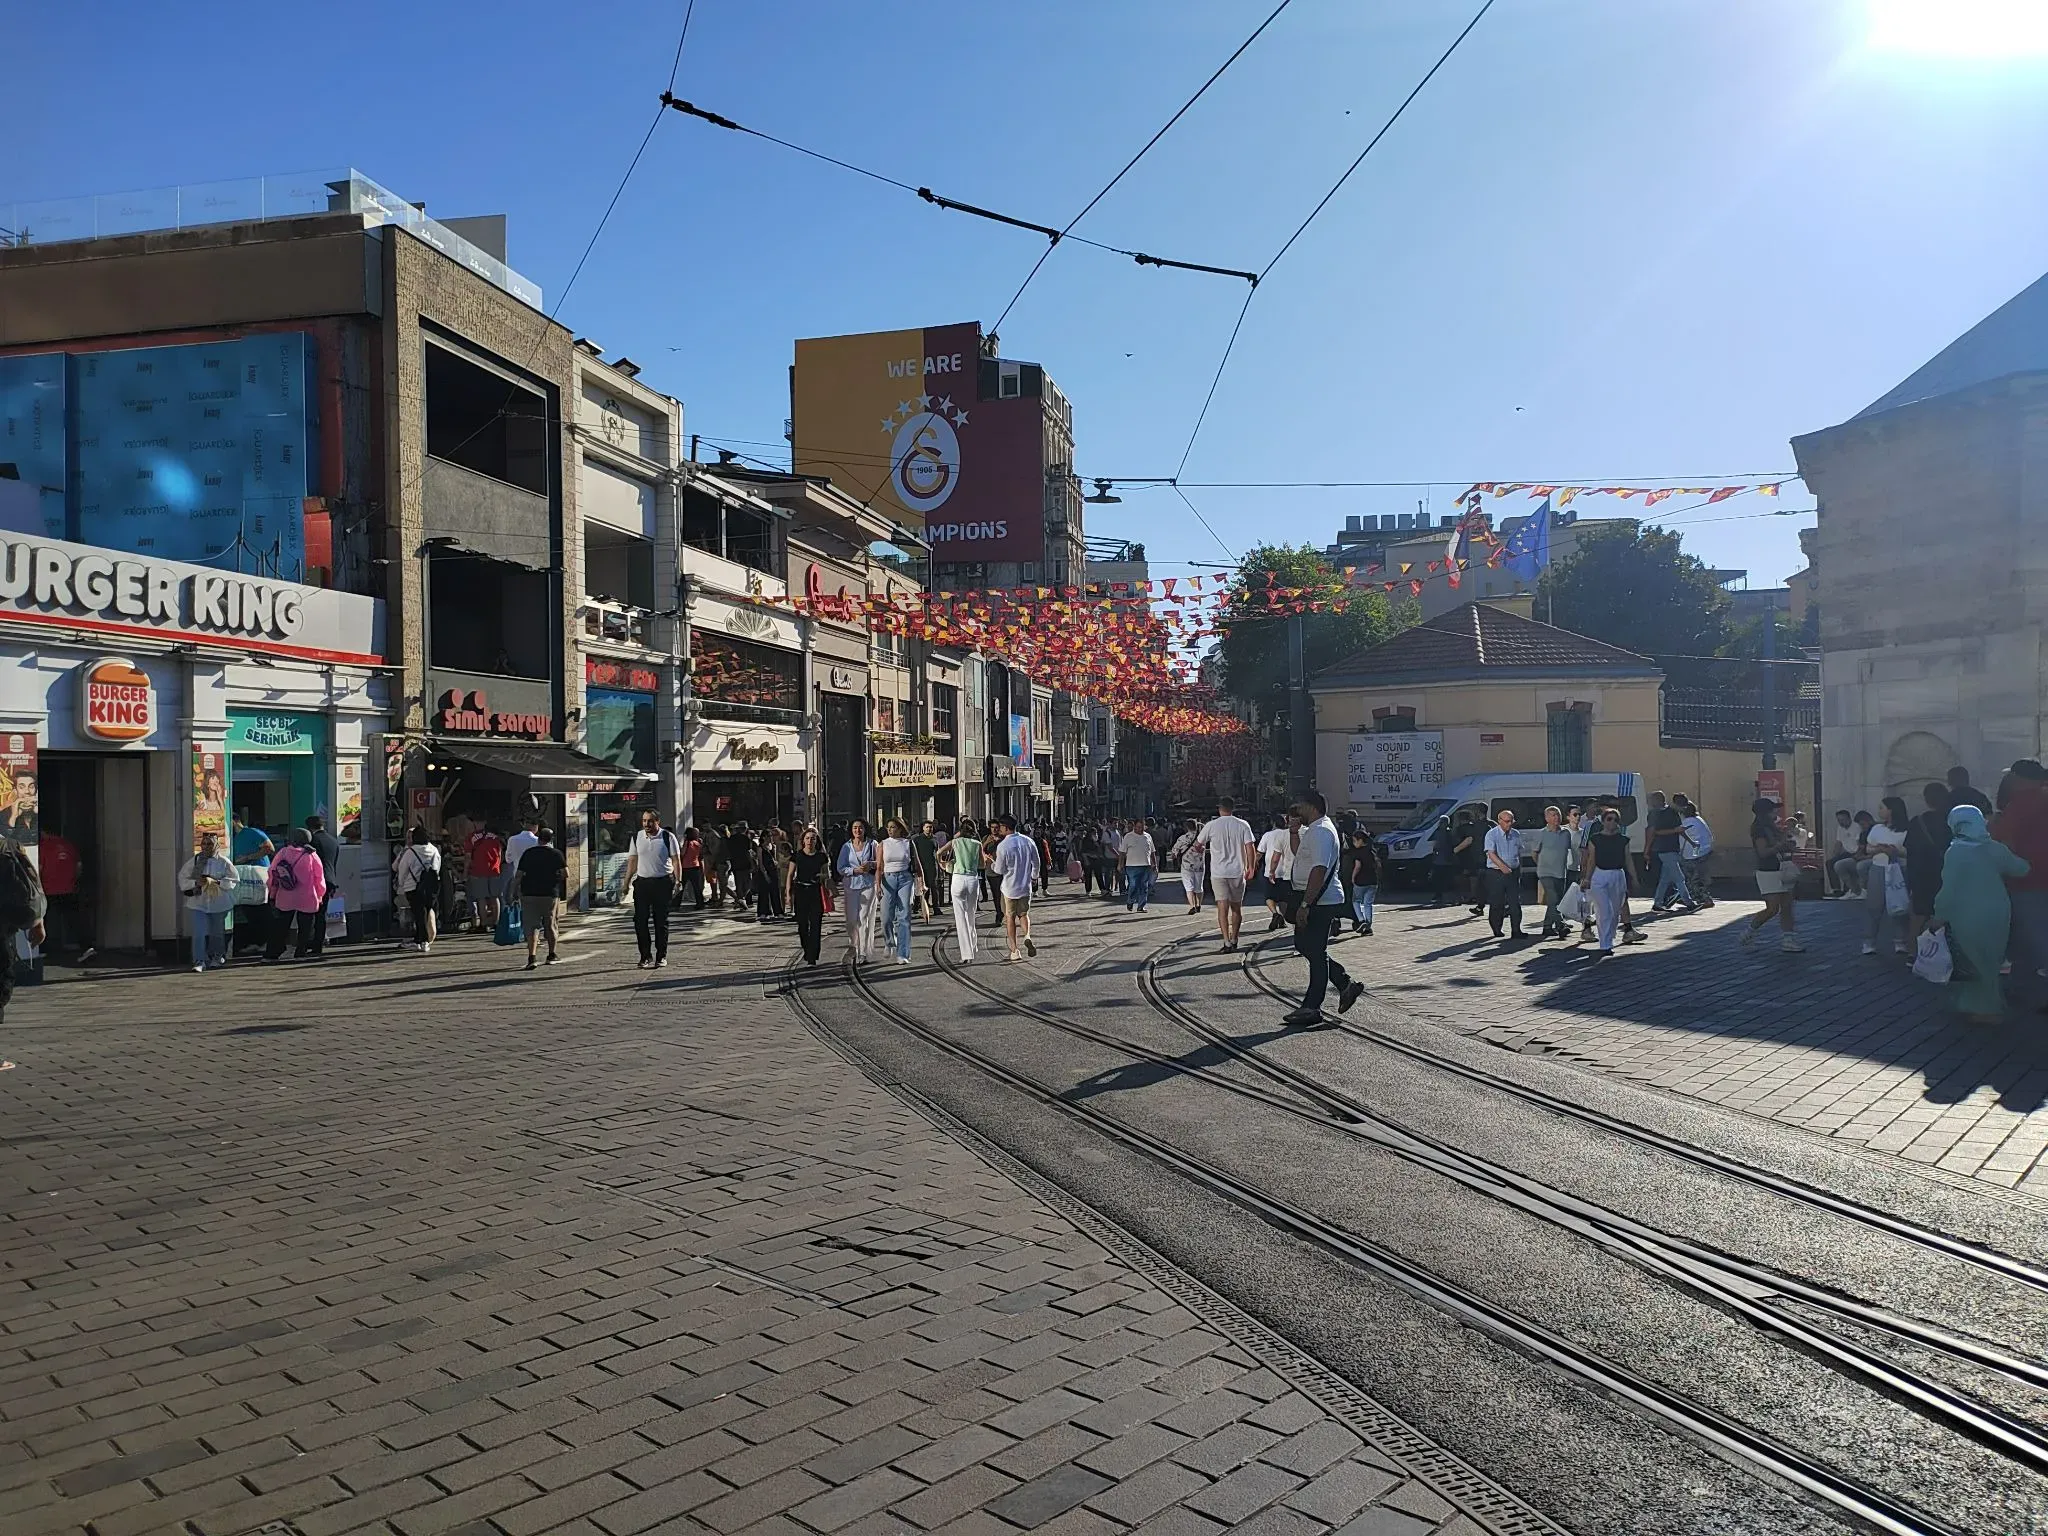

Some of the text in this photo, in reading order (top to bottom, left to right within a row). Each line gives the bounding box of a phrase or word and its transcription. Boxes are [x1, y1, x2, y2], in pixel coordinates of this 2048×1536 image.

[888, 353, 962, 378] WE ARE
[916, 465, 933, 474] 1905
[194, 574, 304, 637] KING
[90, 684, 148, 702] BURGER
[90, 700, 148, 724] KING
[256, 716, 277, 732] SEÇ
[1376, 742, 1411, 752] SOUND
[1387, 753, 1400, 762] OF
[1374, 763, 1413, 773] EUROPE
[1372, 773, 1417, 783] FESTIVAL
[1387, 784, 1401, 793] #4
